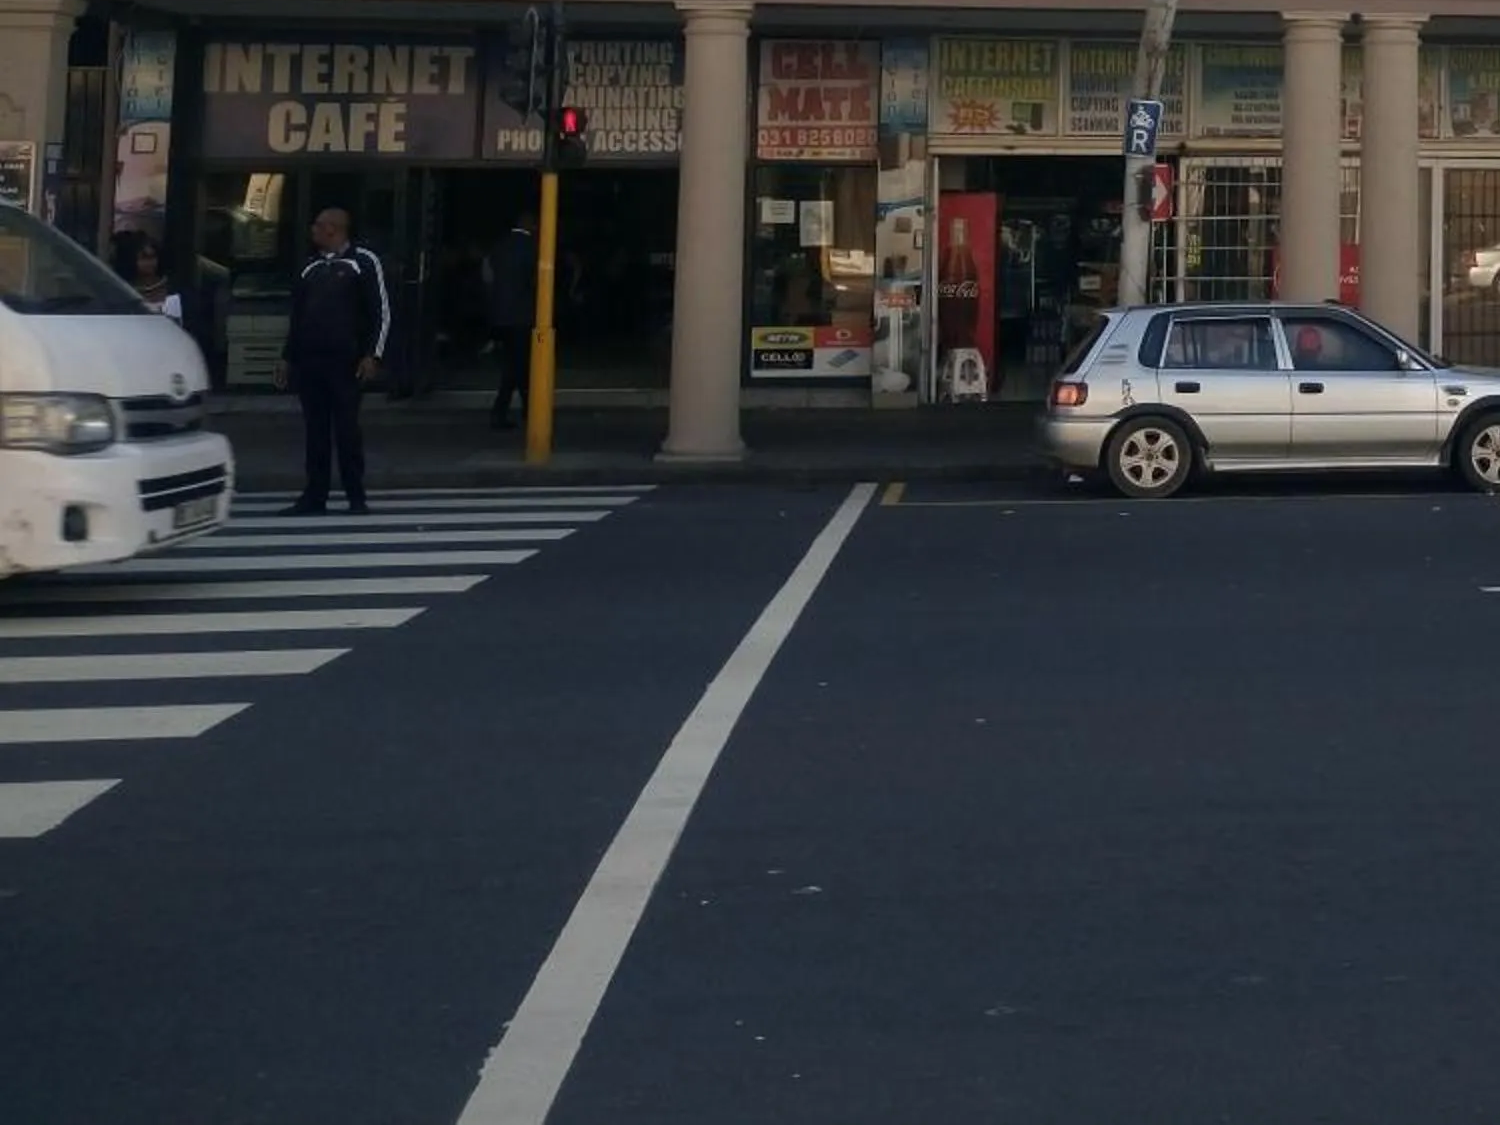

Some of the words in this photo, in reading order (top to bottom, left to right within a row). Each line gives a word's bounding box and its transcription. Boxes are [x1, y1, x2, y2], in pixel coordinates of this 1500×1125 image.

[203, 43, 475, 94] INTERNET
[772, 42, 869, 80] CELL
[940, 41, 1056, 73] INTERNET
[568, 64, 671, 86] COPYING
[562, 85, 686, 108] AMINATING
[768, 85, 871, 122] MATE
[585, 108, 678, 130] ANNING
[593, 130, 683, 153] ACCESS
[1131, 129, 1148, 153] R
